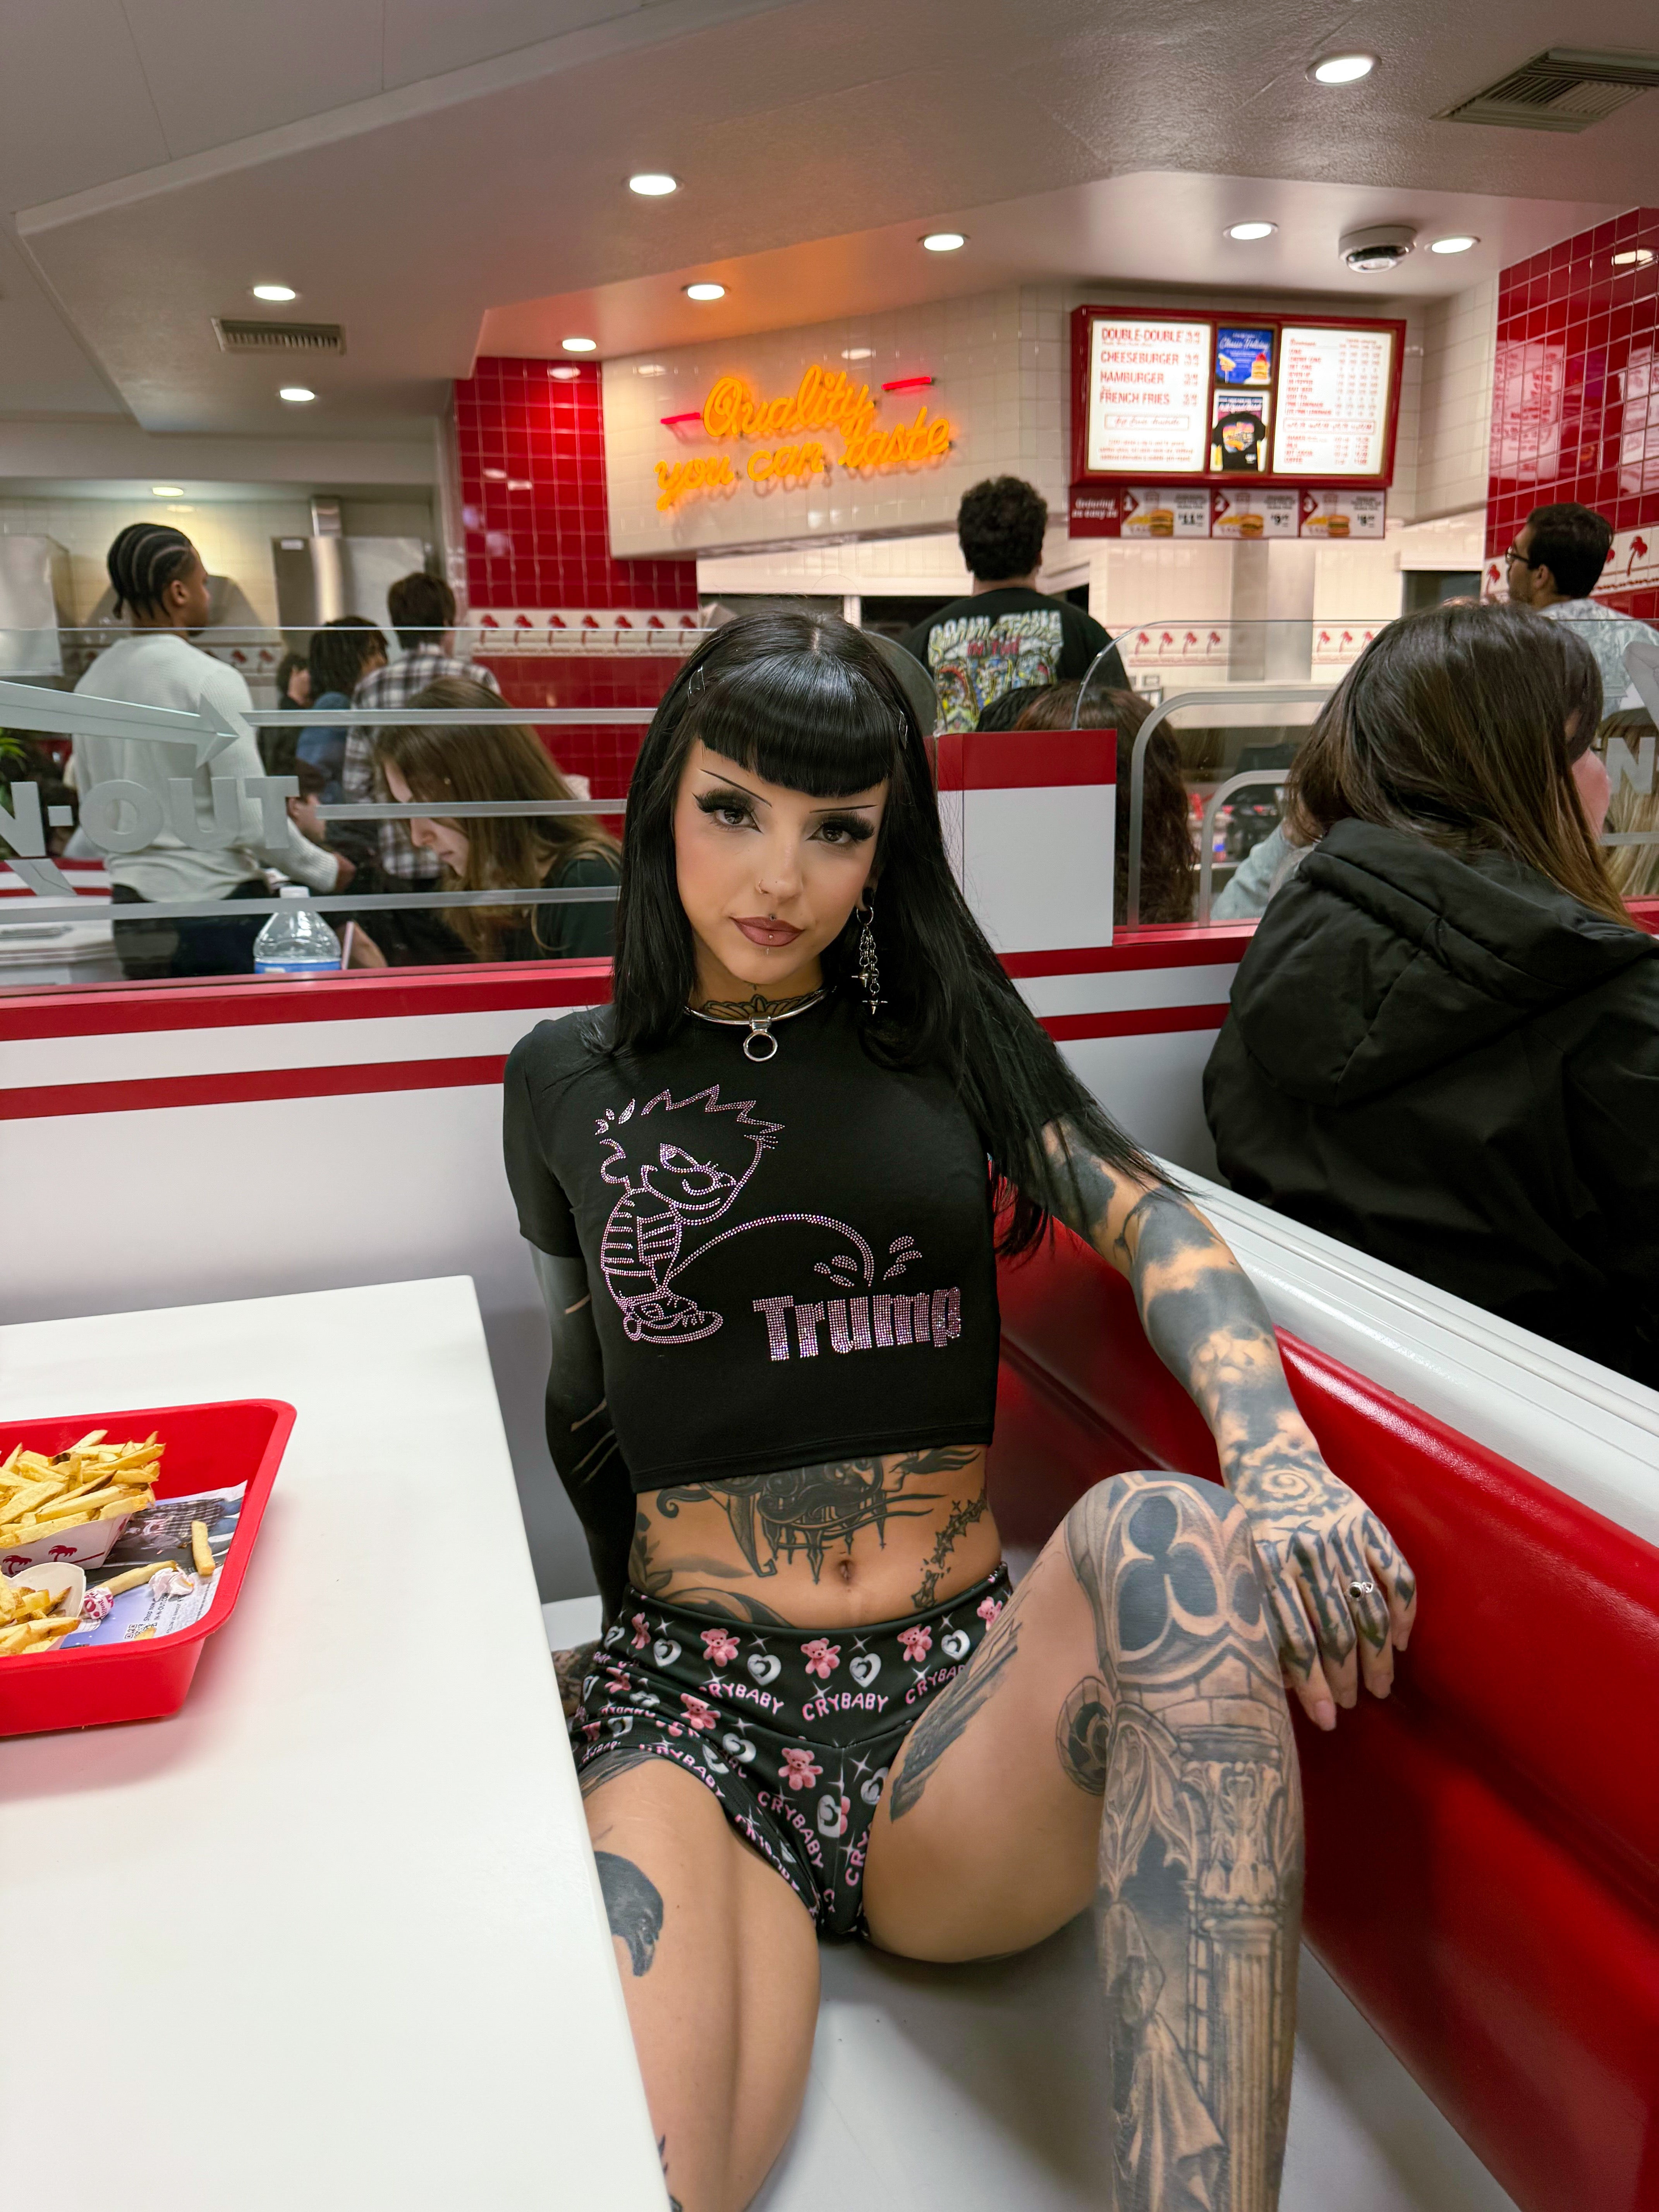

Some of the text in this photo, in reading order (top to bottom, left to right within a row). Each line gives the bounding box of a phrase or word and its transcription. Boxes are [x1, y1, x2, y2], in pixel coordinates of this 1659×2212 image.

[1101, 350, 1178, 365] CHEESEBURGER
[1100, 370, 1164, 384] HAMBURGER
[703, 364, 874, 437] Quality
[1099, 392, 1139, 404] FRENCH
[1142, 393, 1170, 405] FRIES
[654, 406, 950, 512] you can taste
[753, 1286, 962, 1361] Trump
[698, 1682, 784, 1716] RYBABY
[802, 1692, 889, 1721] CRYBABY
[757, 1791, 824, 1869] CRYBABY
